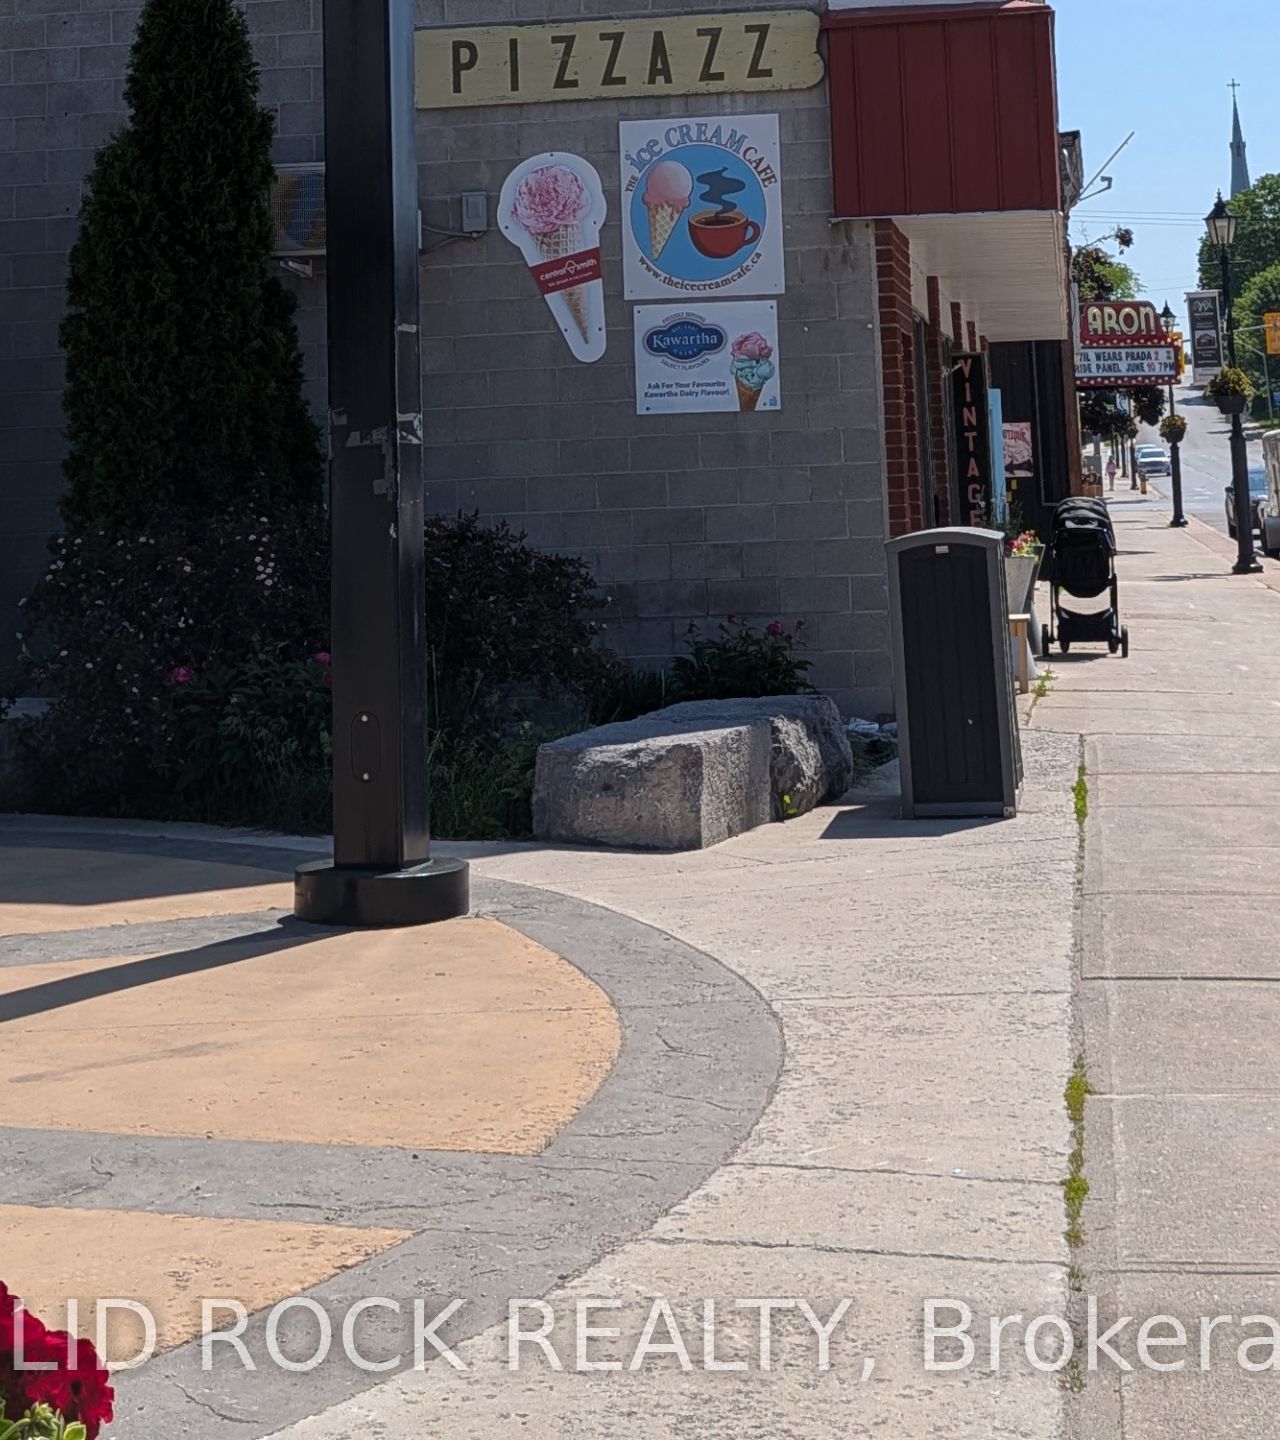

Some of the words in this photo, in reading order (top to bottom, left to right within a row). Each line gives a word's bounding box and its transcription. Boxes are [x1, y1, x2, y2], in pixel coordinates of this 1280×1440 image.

[451, 23, 773, 94] PIZZAZZ
[625, 174, 639, 192] THE
[664, 122, 748, 153] CREAM
[743, 146, 778, 188] CAFE
[639, 251, 762, 291] www.theicecreamcafe.ca
[1087, 306, 1156, 335] ARON
[653, 332, 717, 348] Kawartha
[1094, 352, 1123, 362] WEARS
[1125, 351, 1152, 361] PRADA
[1152, 351, 1159, 361] 2
[1096, 363, 1122, 373] PANEL
[1126, 362, 1145, 372] JUNE
[1146, 363, 1156, 372] 10
[647, 382, 660, 390] Ask
[692, 380, 726, 388] Favourite
[644, 390, 679, 398] Kawartha
[680, 389, 699, 398] Dairy
